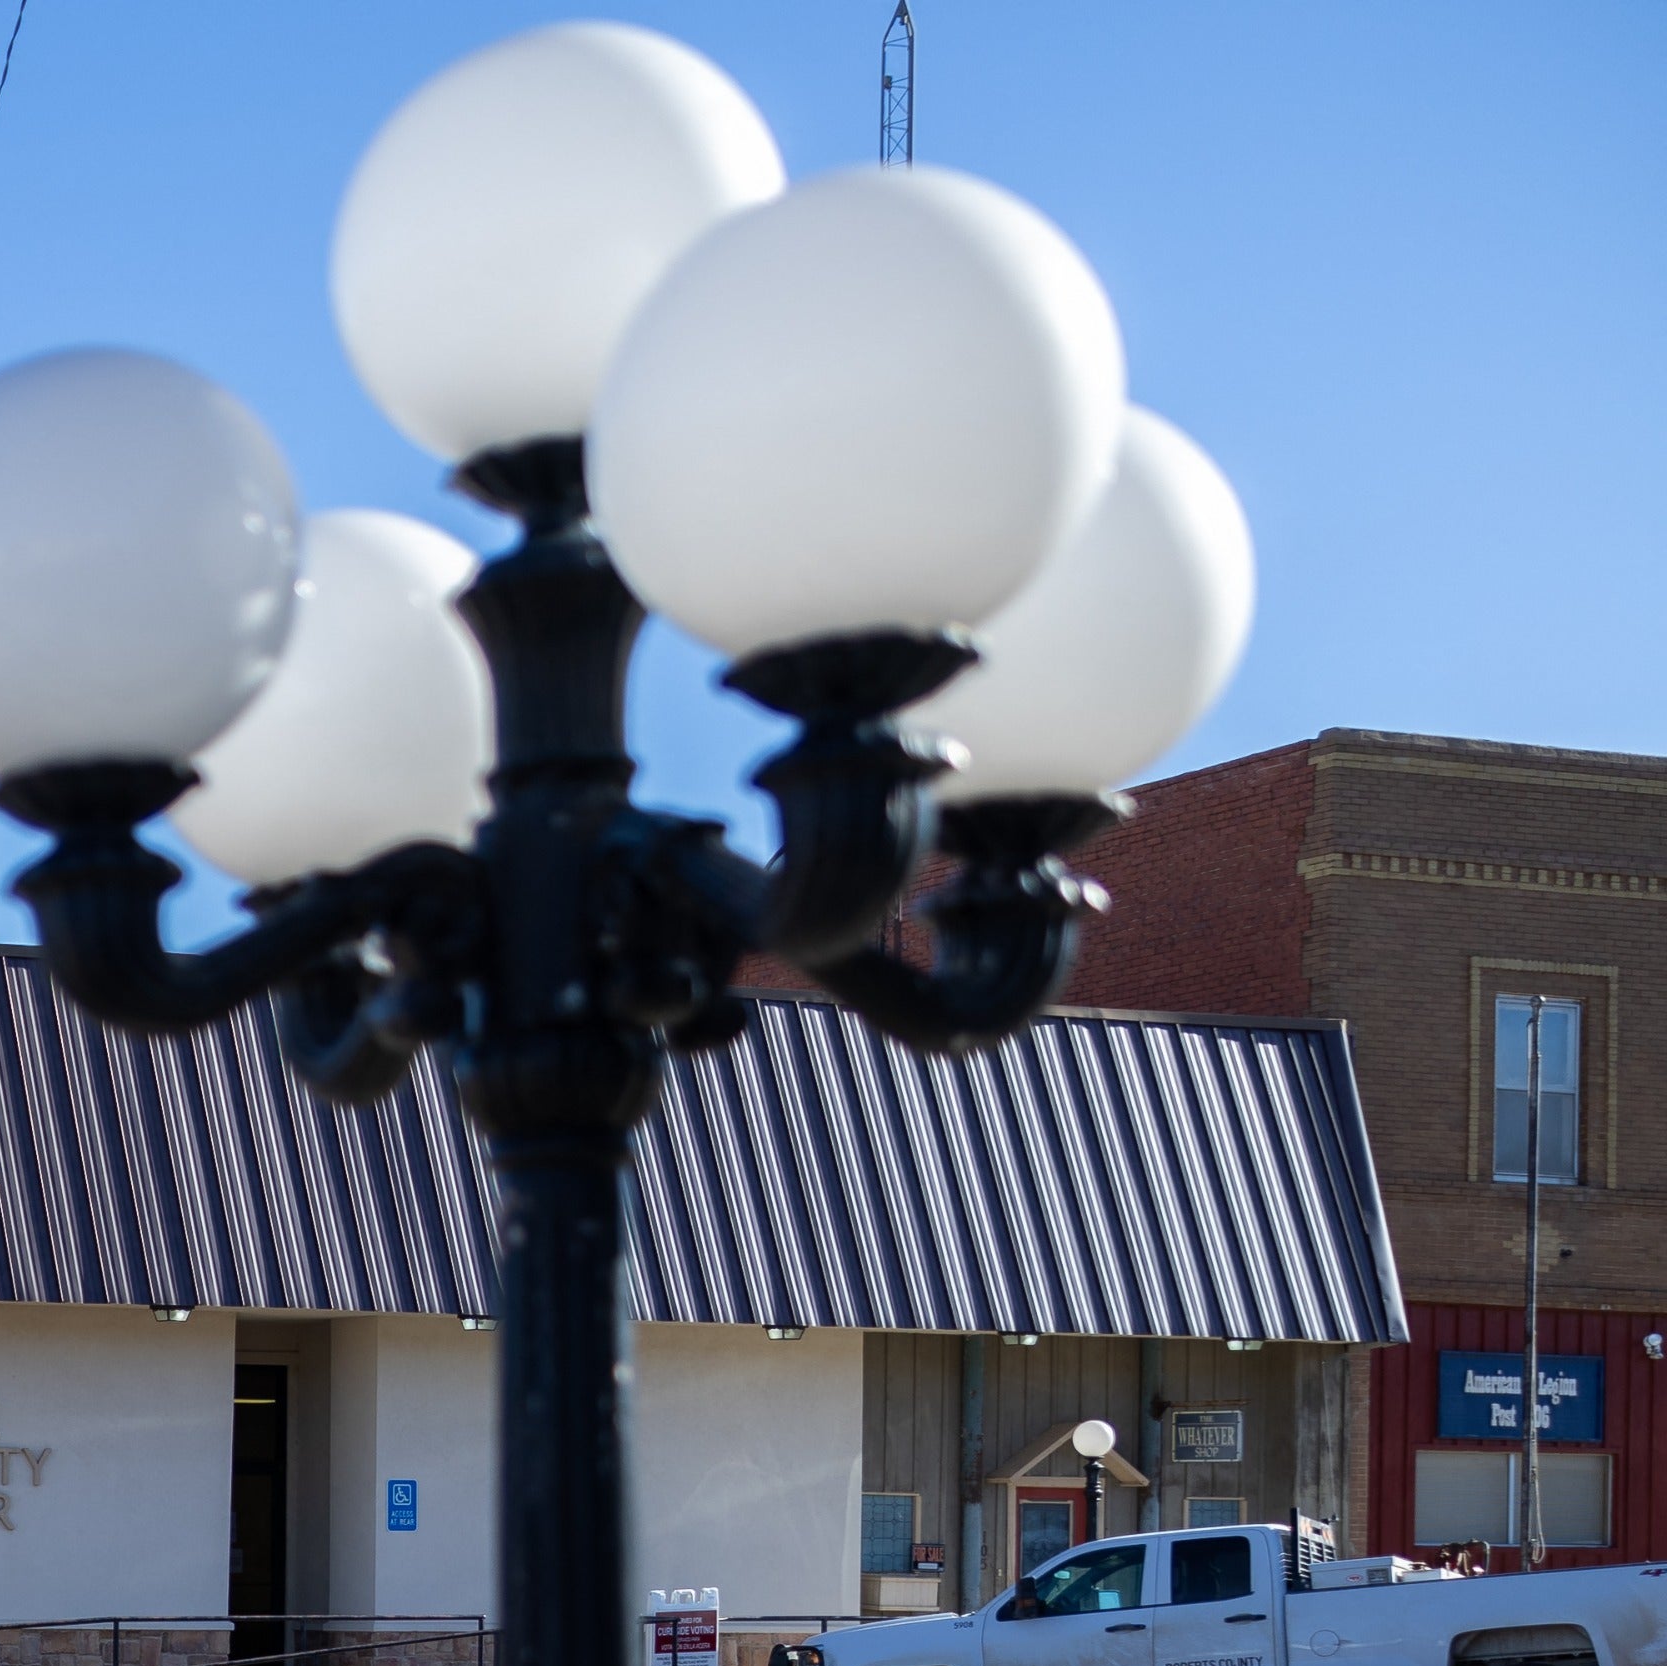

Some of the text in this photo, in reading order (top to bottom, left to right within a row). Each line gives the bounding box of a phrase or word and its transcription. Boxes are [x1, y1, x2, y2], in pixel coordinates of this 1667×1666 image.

[1464, 1369, 1578, 1405] American Legion
[1490, 1402, 1517, 1428] Post
[1177, 1426, 1235, 1447] WHATEVER
[1194, 1447, 1219, 1458] SHOP
[391, 1510, 414, 1518] ACCESS
[691, 1625, 715, 1635] VOTING
